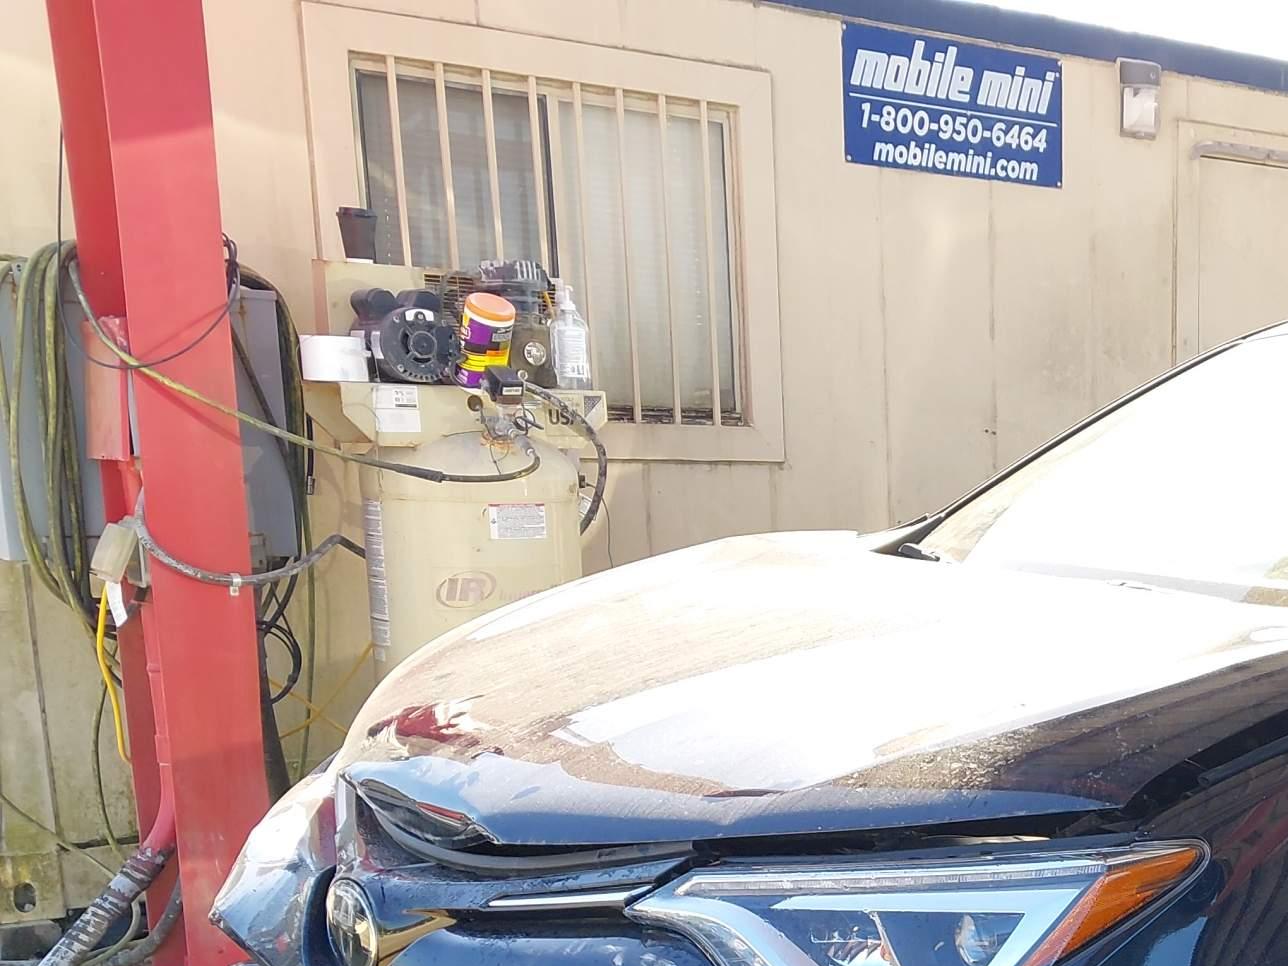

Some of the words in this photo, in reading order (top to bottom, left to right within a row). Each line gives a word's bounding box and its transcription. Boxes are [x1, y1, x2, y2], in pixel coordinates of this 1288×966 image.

[850, 39, 974, 103] mobile
[976, 66, 1055, 115] mini
[861, 102, 1048, 153] 1-800-950-6464
[873, 141, 1038, 181] mobilemini.com
[548, 409, 577, 426] US
